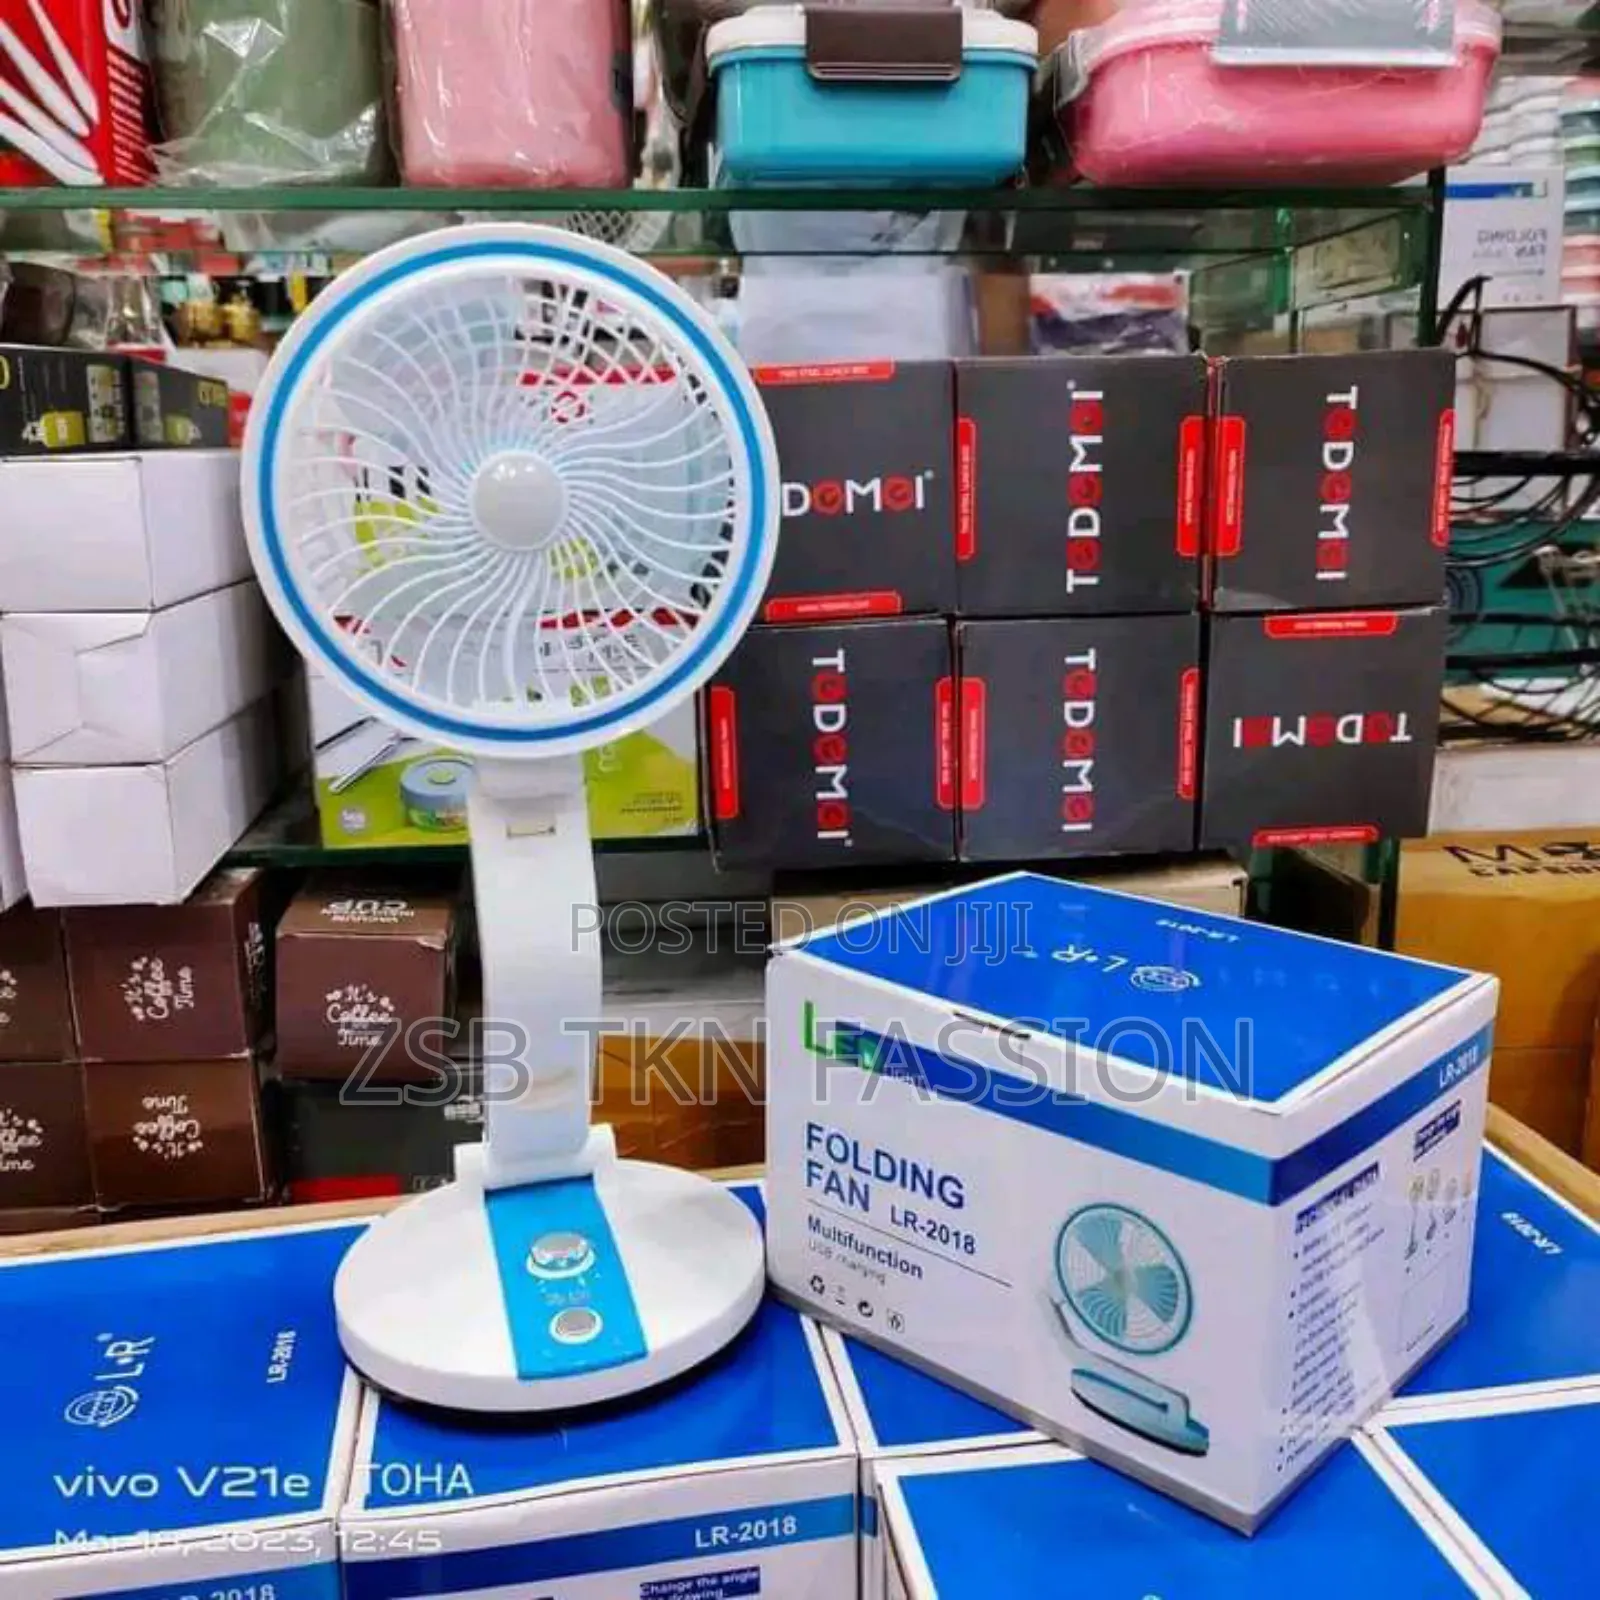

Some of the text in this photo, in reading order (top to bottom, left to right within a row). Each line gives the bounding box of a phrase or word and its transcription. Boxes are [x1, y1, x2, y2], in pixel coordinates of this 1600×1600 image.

[144, 957, 173, 1019] Coffee
[326, 1002, 392, 1028] Coffee
[338, 1027, 383, 1046] Time
[133, 1114, 201, 1141] Coffee
[806, 1122, 966, 1210] FOLDING
[806, 1160, 977, 1256] FAN LR-2018
[808, 1214, 925, 1281] Multifunction
[694, 1514, 798, 1549] LR-2018
[696, 1577, 718, 1589] the
